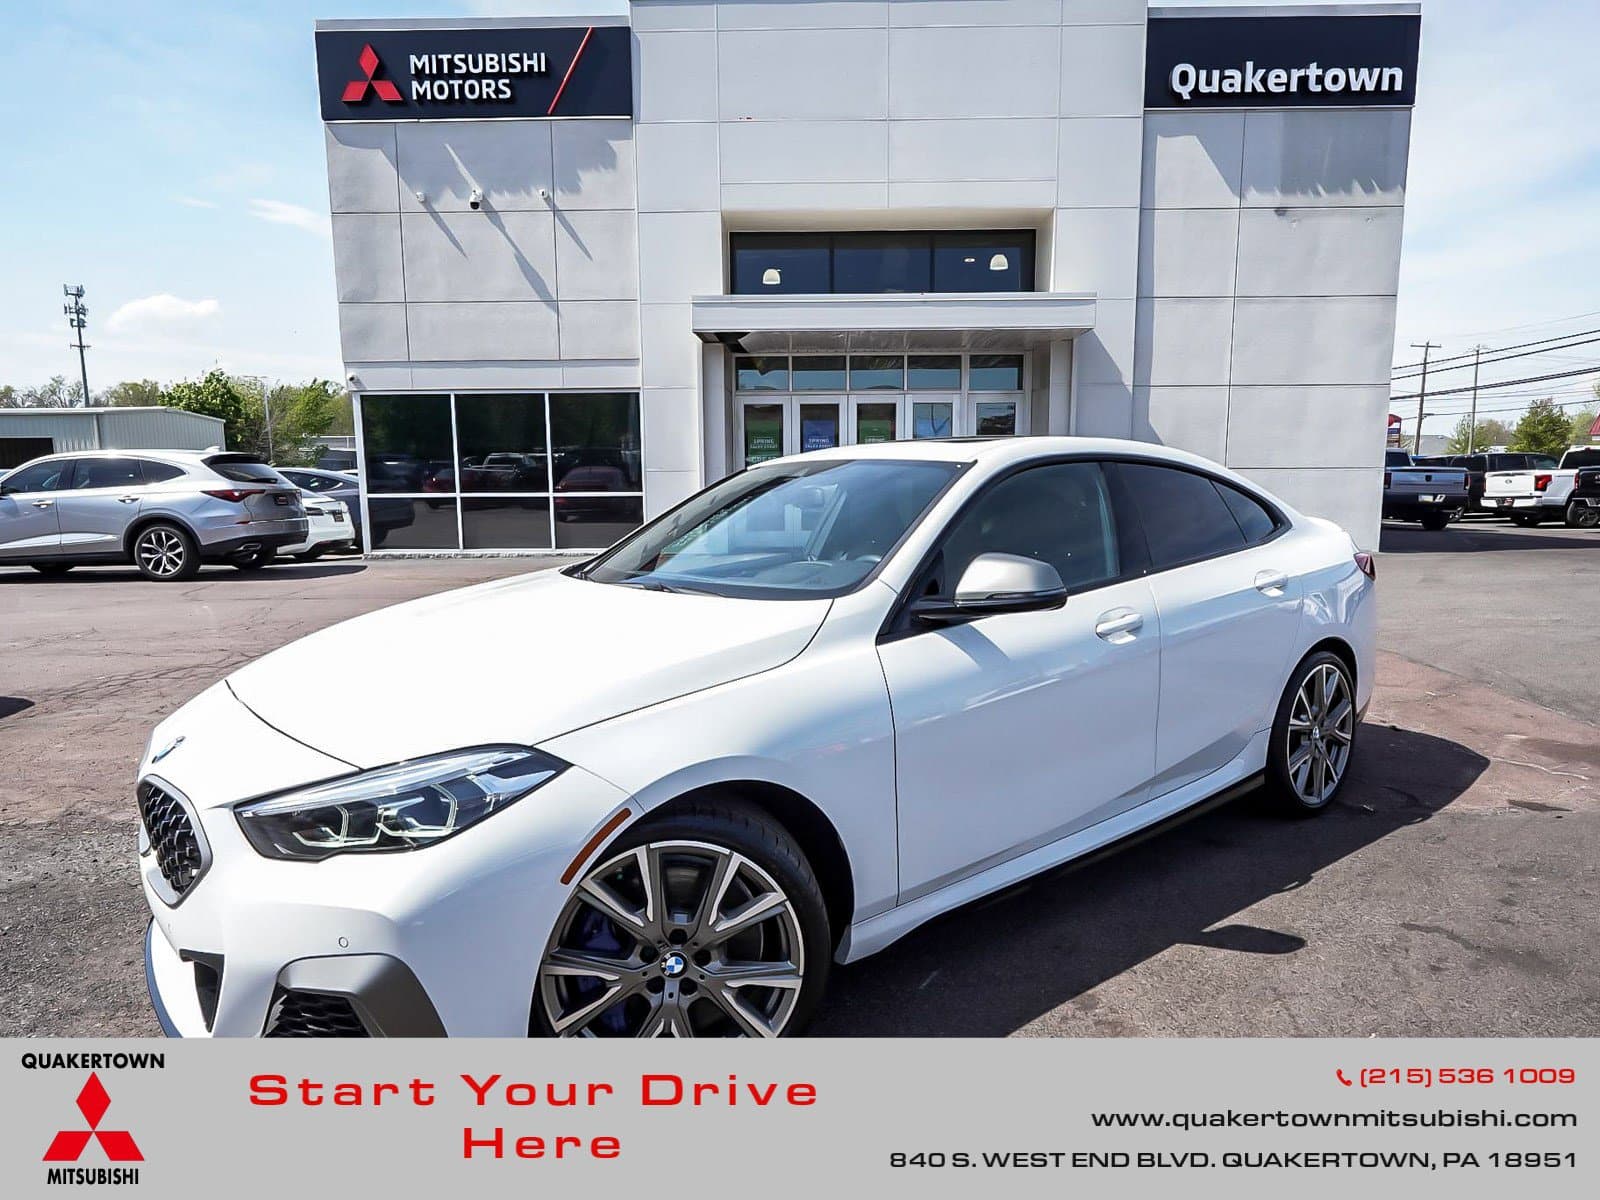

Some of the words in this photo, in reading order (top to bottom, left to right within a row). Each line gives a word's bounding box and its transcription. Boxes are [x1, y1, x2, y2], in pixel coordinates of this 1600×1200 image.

[409, 52, 546, 74] MITSUBISHI
[411, 79, 511, 100] MOTORS
[1171, 61, 1403, 100] Quakertown
